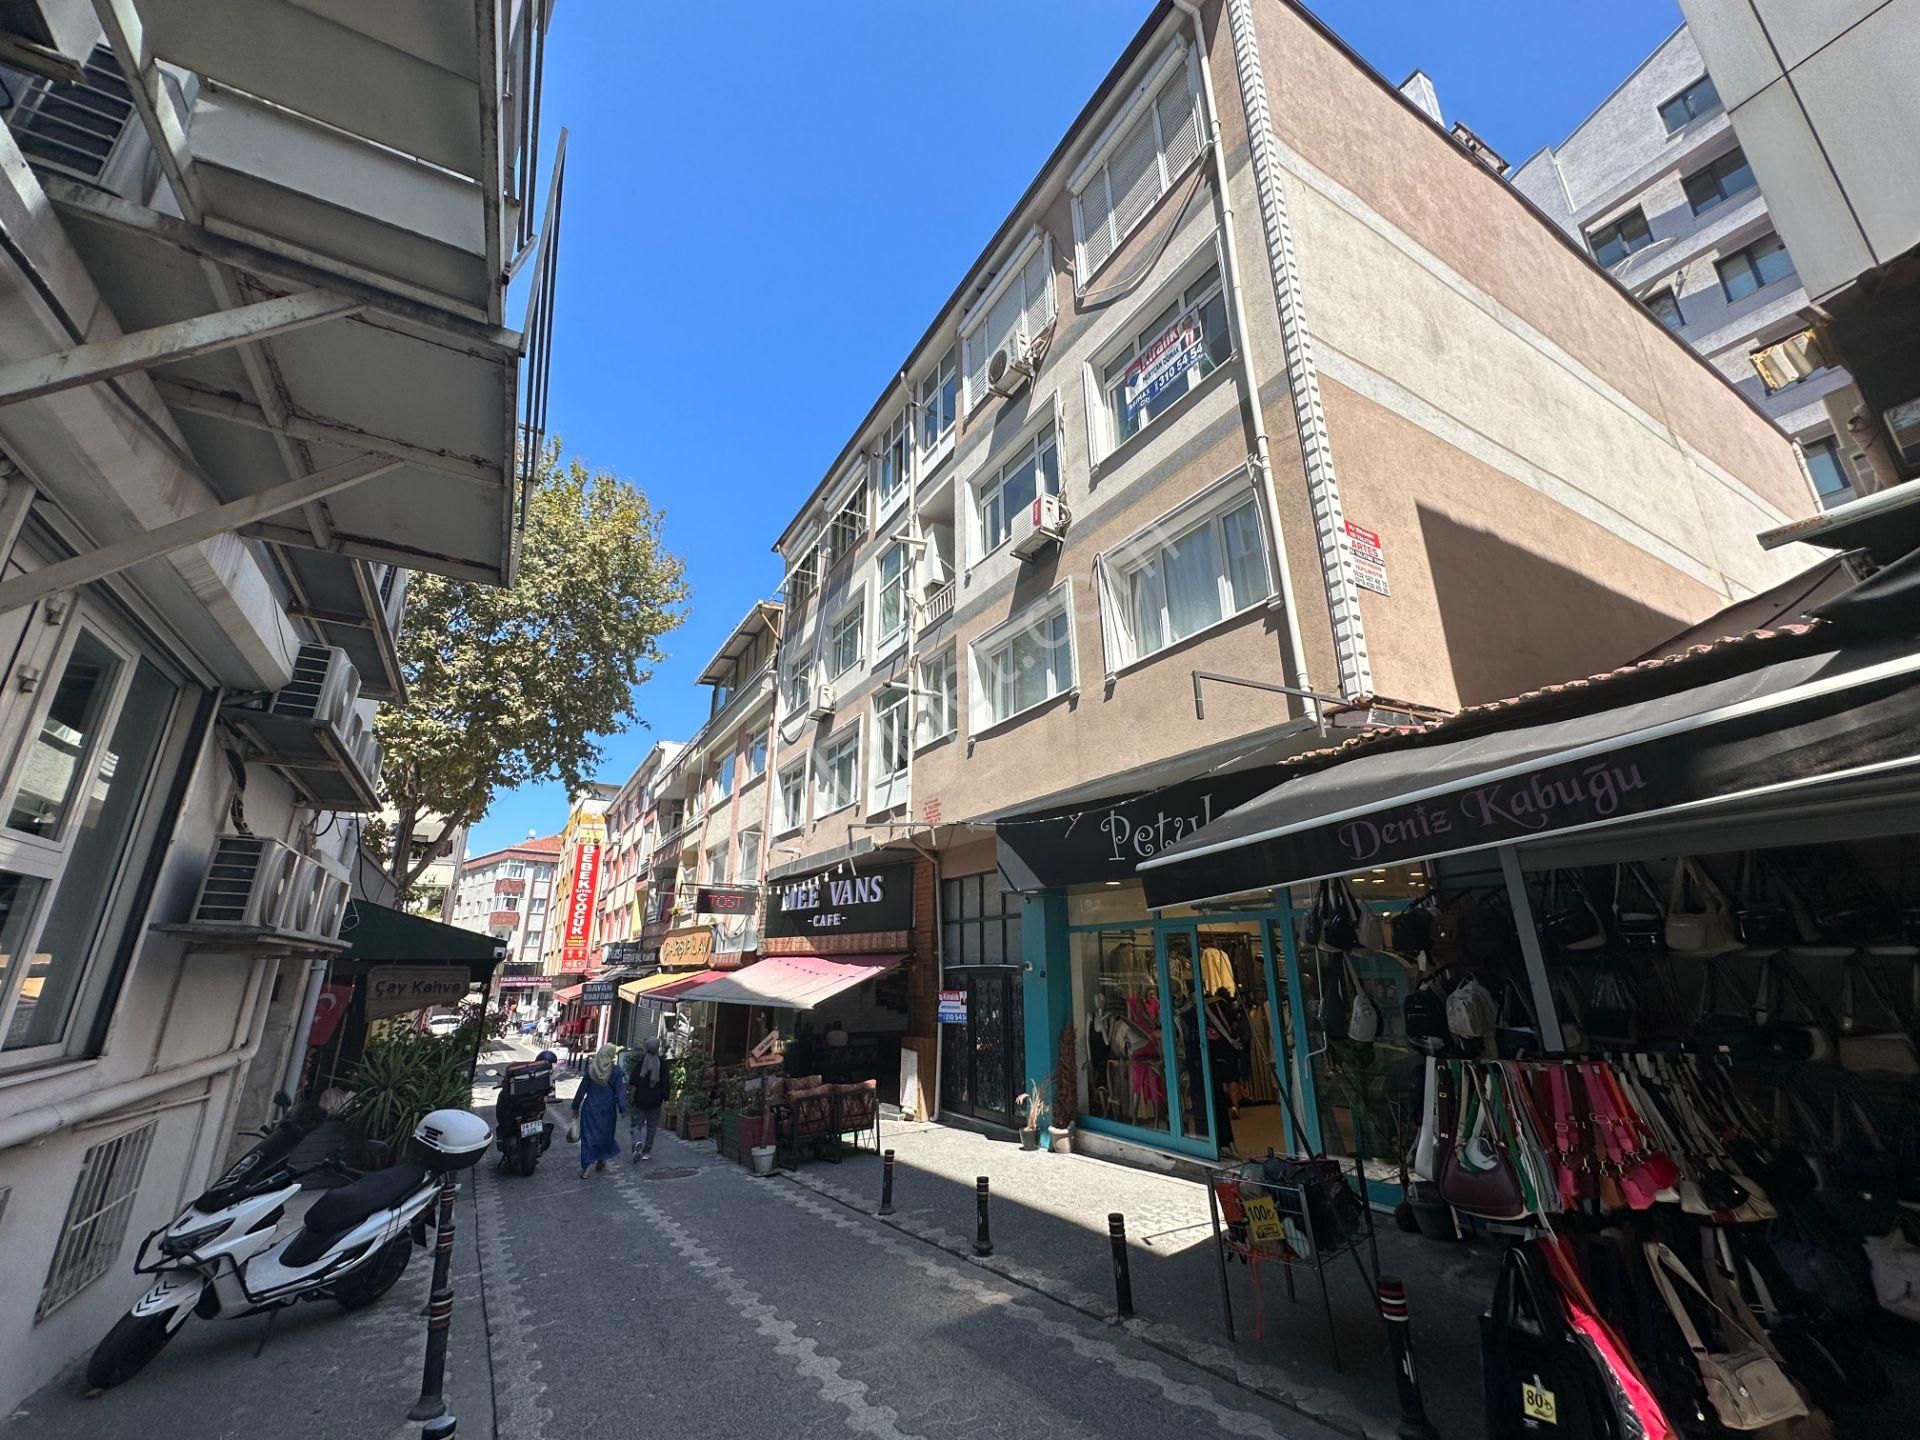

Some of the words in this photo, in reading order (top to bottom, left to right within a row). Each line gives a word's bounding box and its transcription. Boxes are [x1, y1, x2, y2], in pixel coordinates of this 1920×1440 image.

[1159, 367, 1175, 387] 310
[1176, 354, 1188, 371] 54
[1190, 343, 1203, 359] 54
[1351, 540, 1378, 557] ARTES
[1338, 805, 1452, 862] Deniz
[1460, 762, 1648, 830] Kabuğu
[577, 845, 595, 888] BEBEK
[829, 875, 884, 906] VANS
[375, 980, 407, 997] Çay
[411, 980, 461, 994] Kahve
